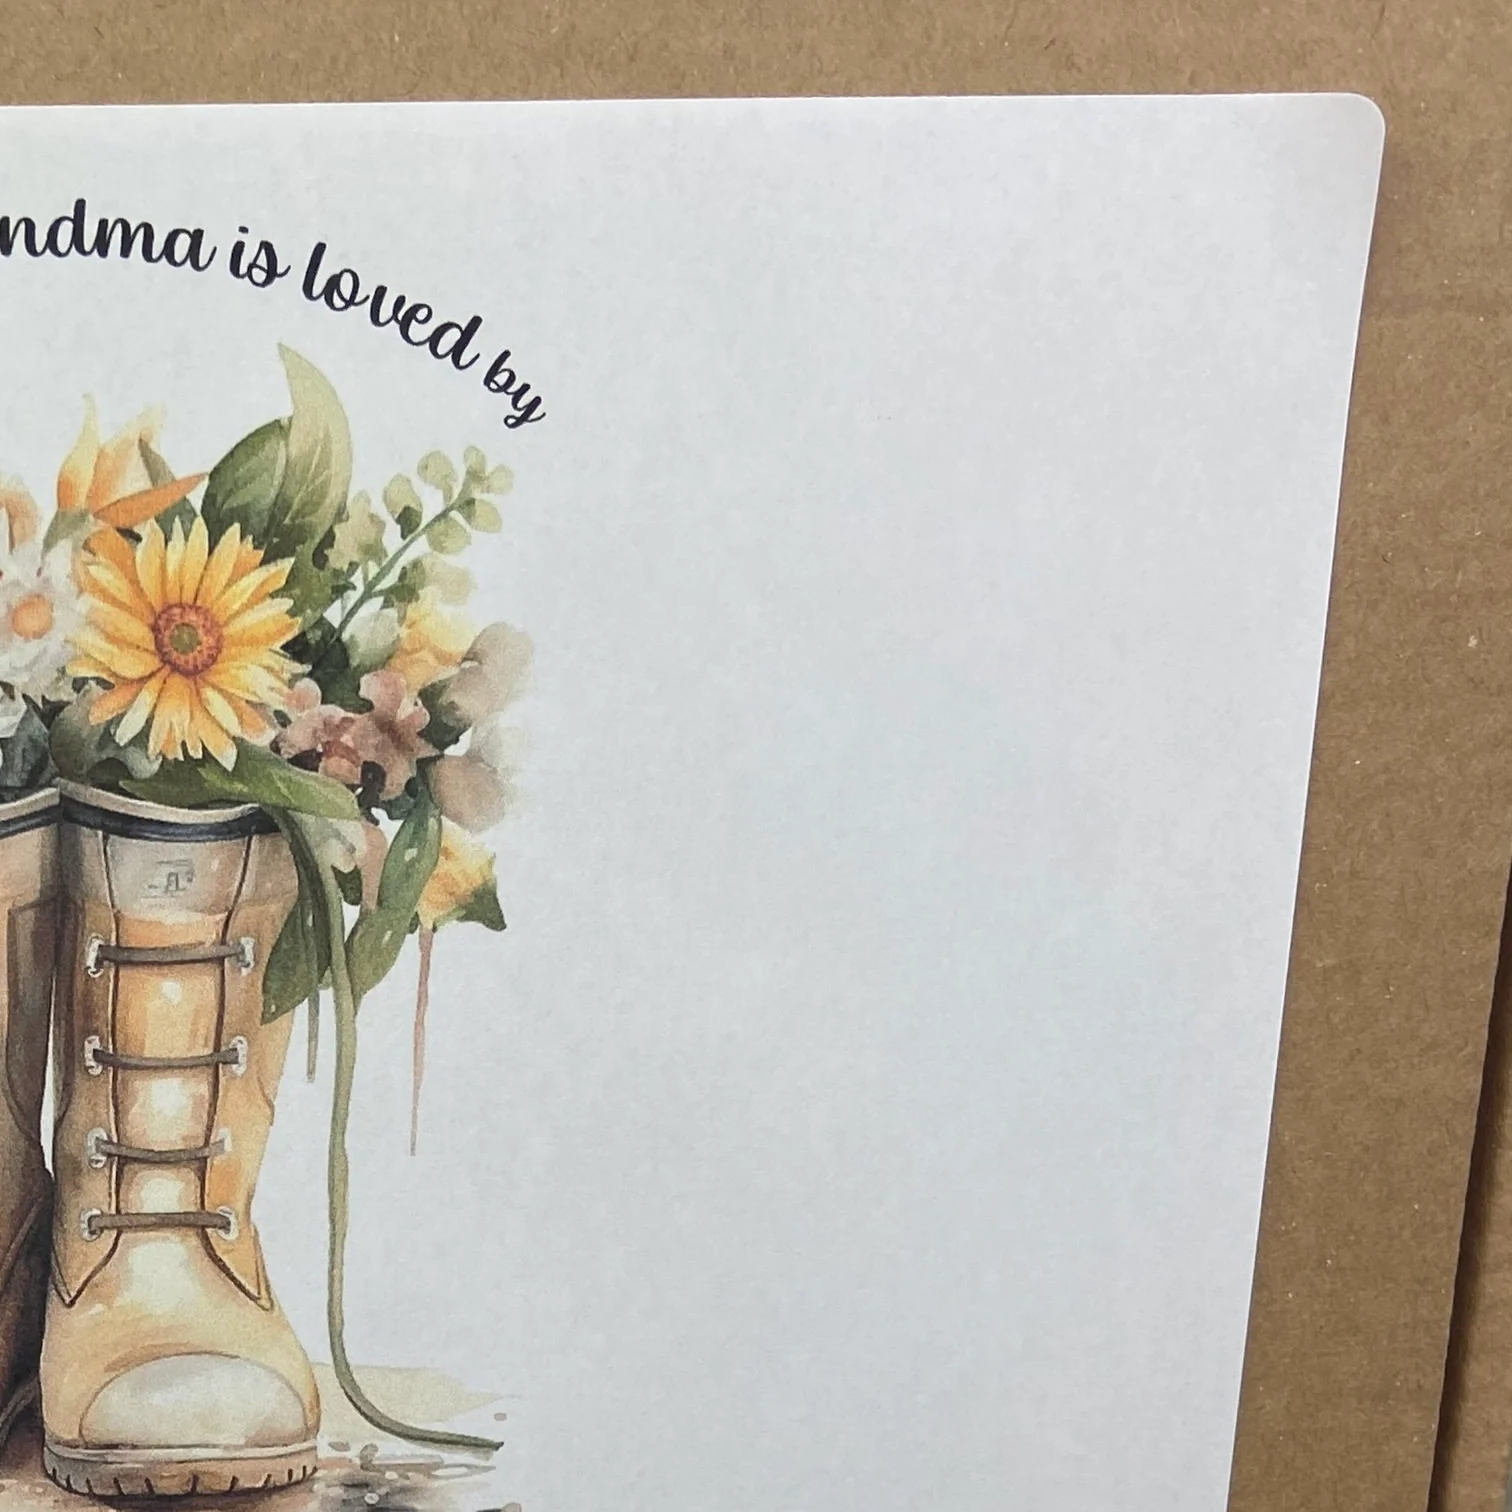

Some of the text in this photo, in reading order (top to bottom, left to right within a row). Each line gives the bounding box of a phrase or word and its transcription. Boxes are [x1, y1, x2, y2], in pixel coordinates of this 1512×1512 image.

[229, 226, 291, 288] is
[302, 242, 482, 371] loved
[484, 350, 548, 430] by
